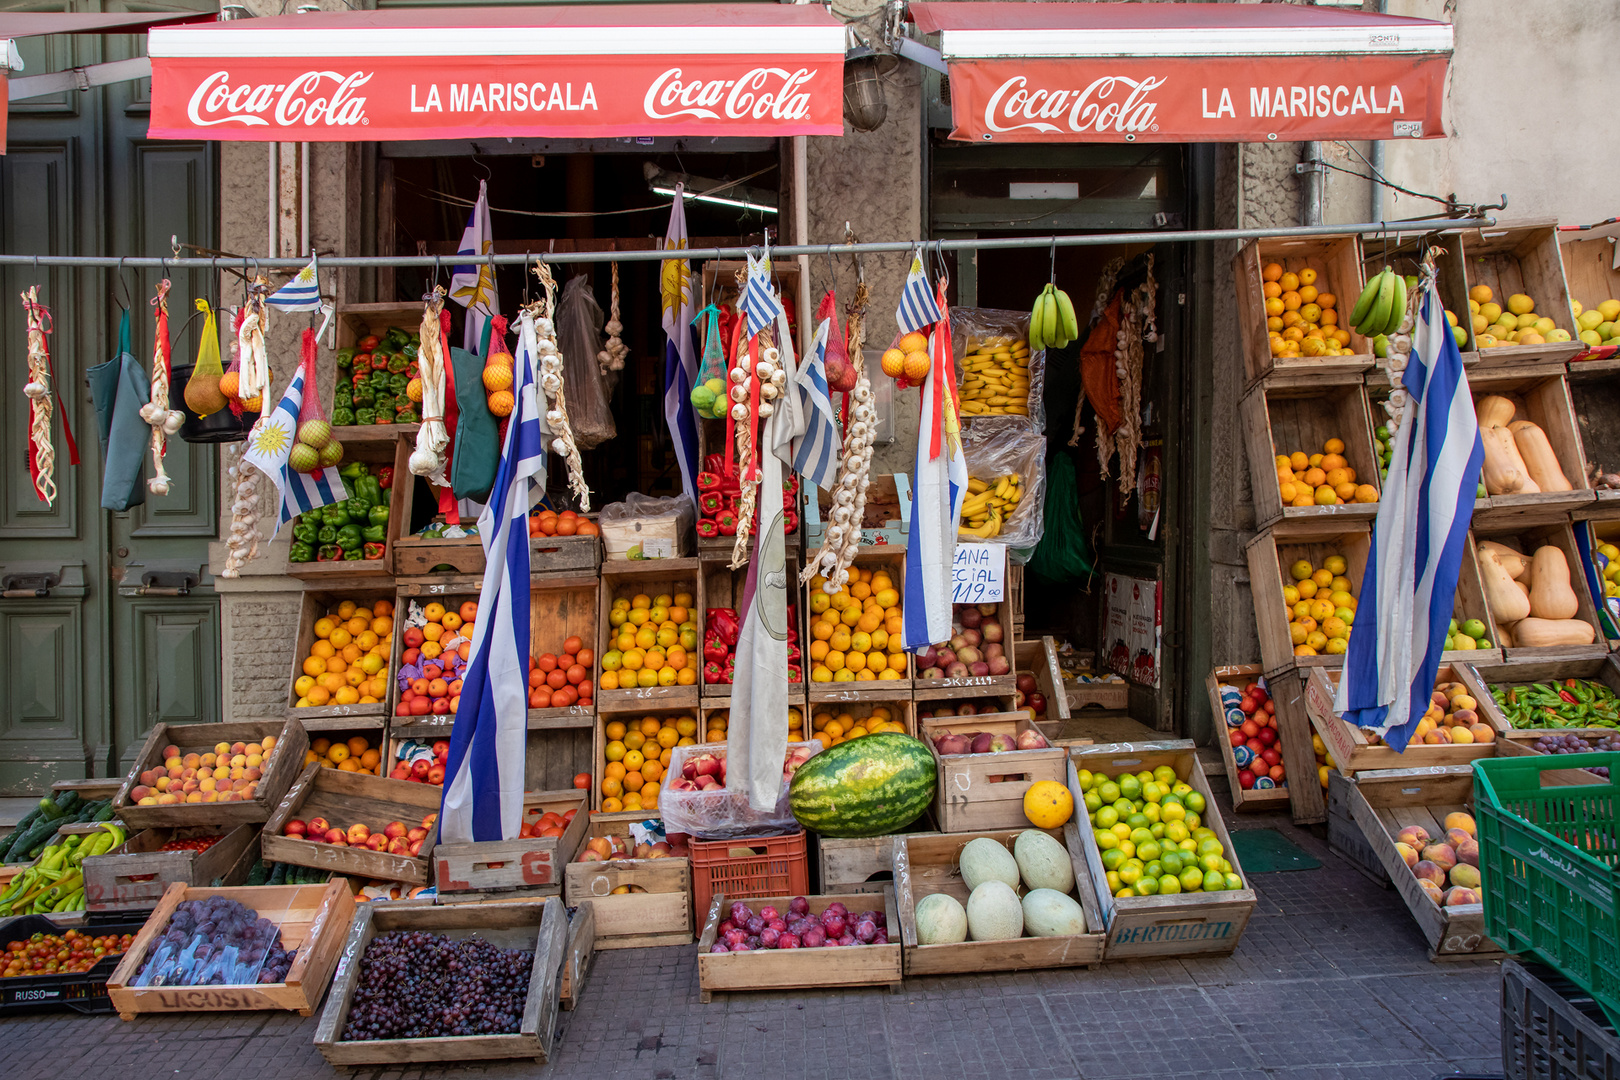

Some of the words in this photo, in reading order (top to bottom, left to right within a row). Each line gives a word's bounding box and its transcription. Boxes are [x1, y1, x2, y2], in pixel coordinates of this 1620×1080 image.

[187, 71, 374, 127] Coca-Cola
[410, 83, 443, 113] LA
[449, 82, 598, 112] MARISCALA
[643, 67, 818, 120] Coca-Cola
[984, 76, 1168, 133] Coca-Cola
[1202, 87, 1236, 118] LA
[1250, 85, 1404, 118] MARISCALA
[430, 585, 445, 593] 39
[1116, 921, 1231, 944] BERTOLOTTI
[15, 990, 46, 1000] RUSSO
